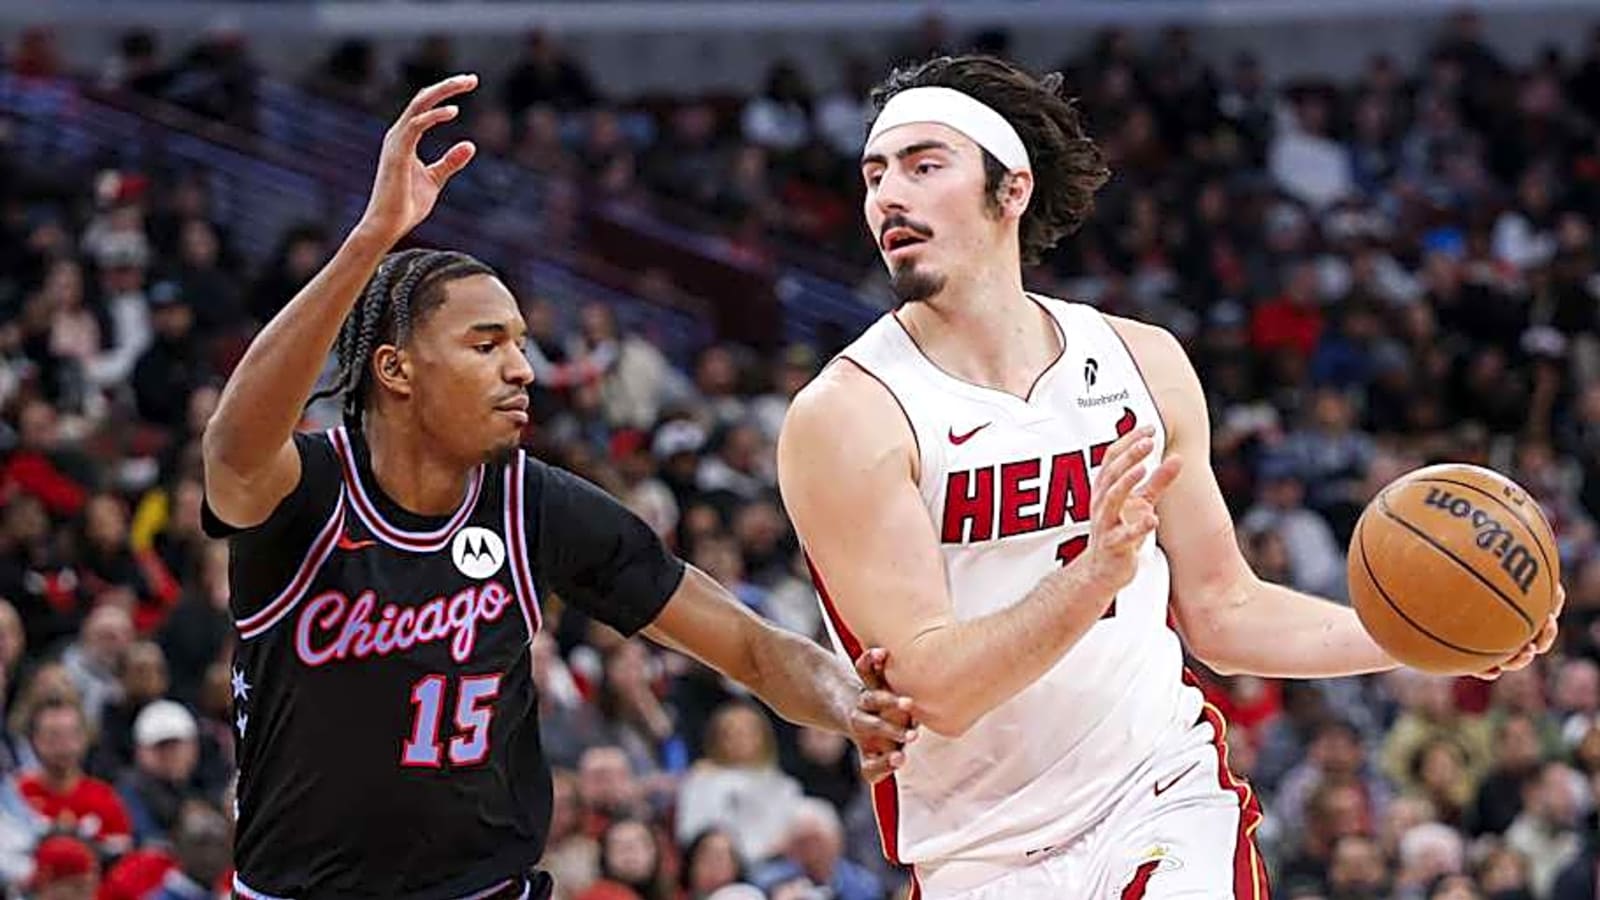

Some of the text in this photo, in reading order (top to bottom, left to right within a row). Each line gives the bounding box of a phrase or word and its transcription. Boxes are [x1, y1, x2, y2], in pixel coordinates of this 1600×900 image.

[1424, 487, 1539, 595] Wilson
[295, 580, 513, 667] Chicago
[401, 672, 505, 768] 15
